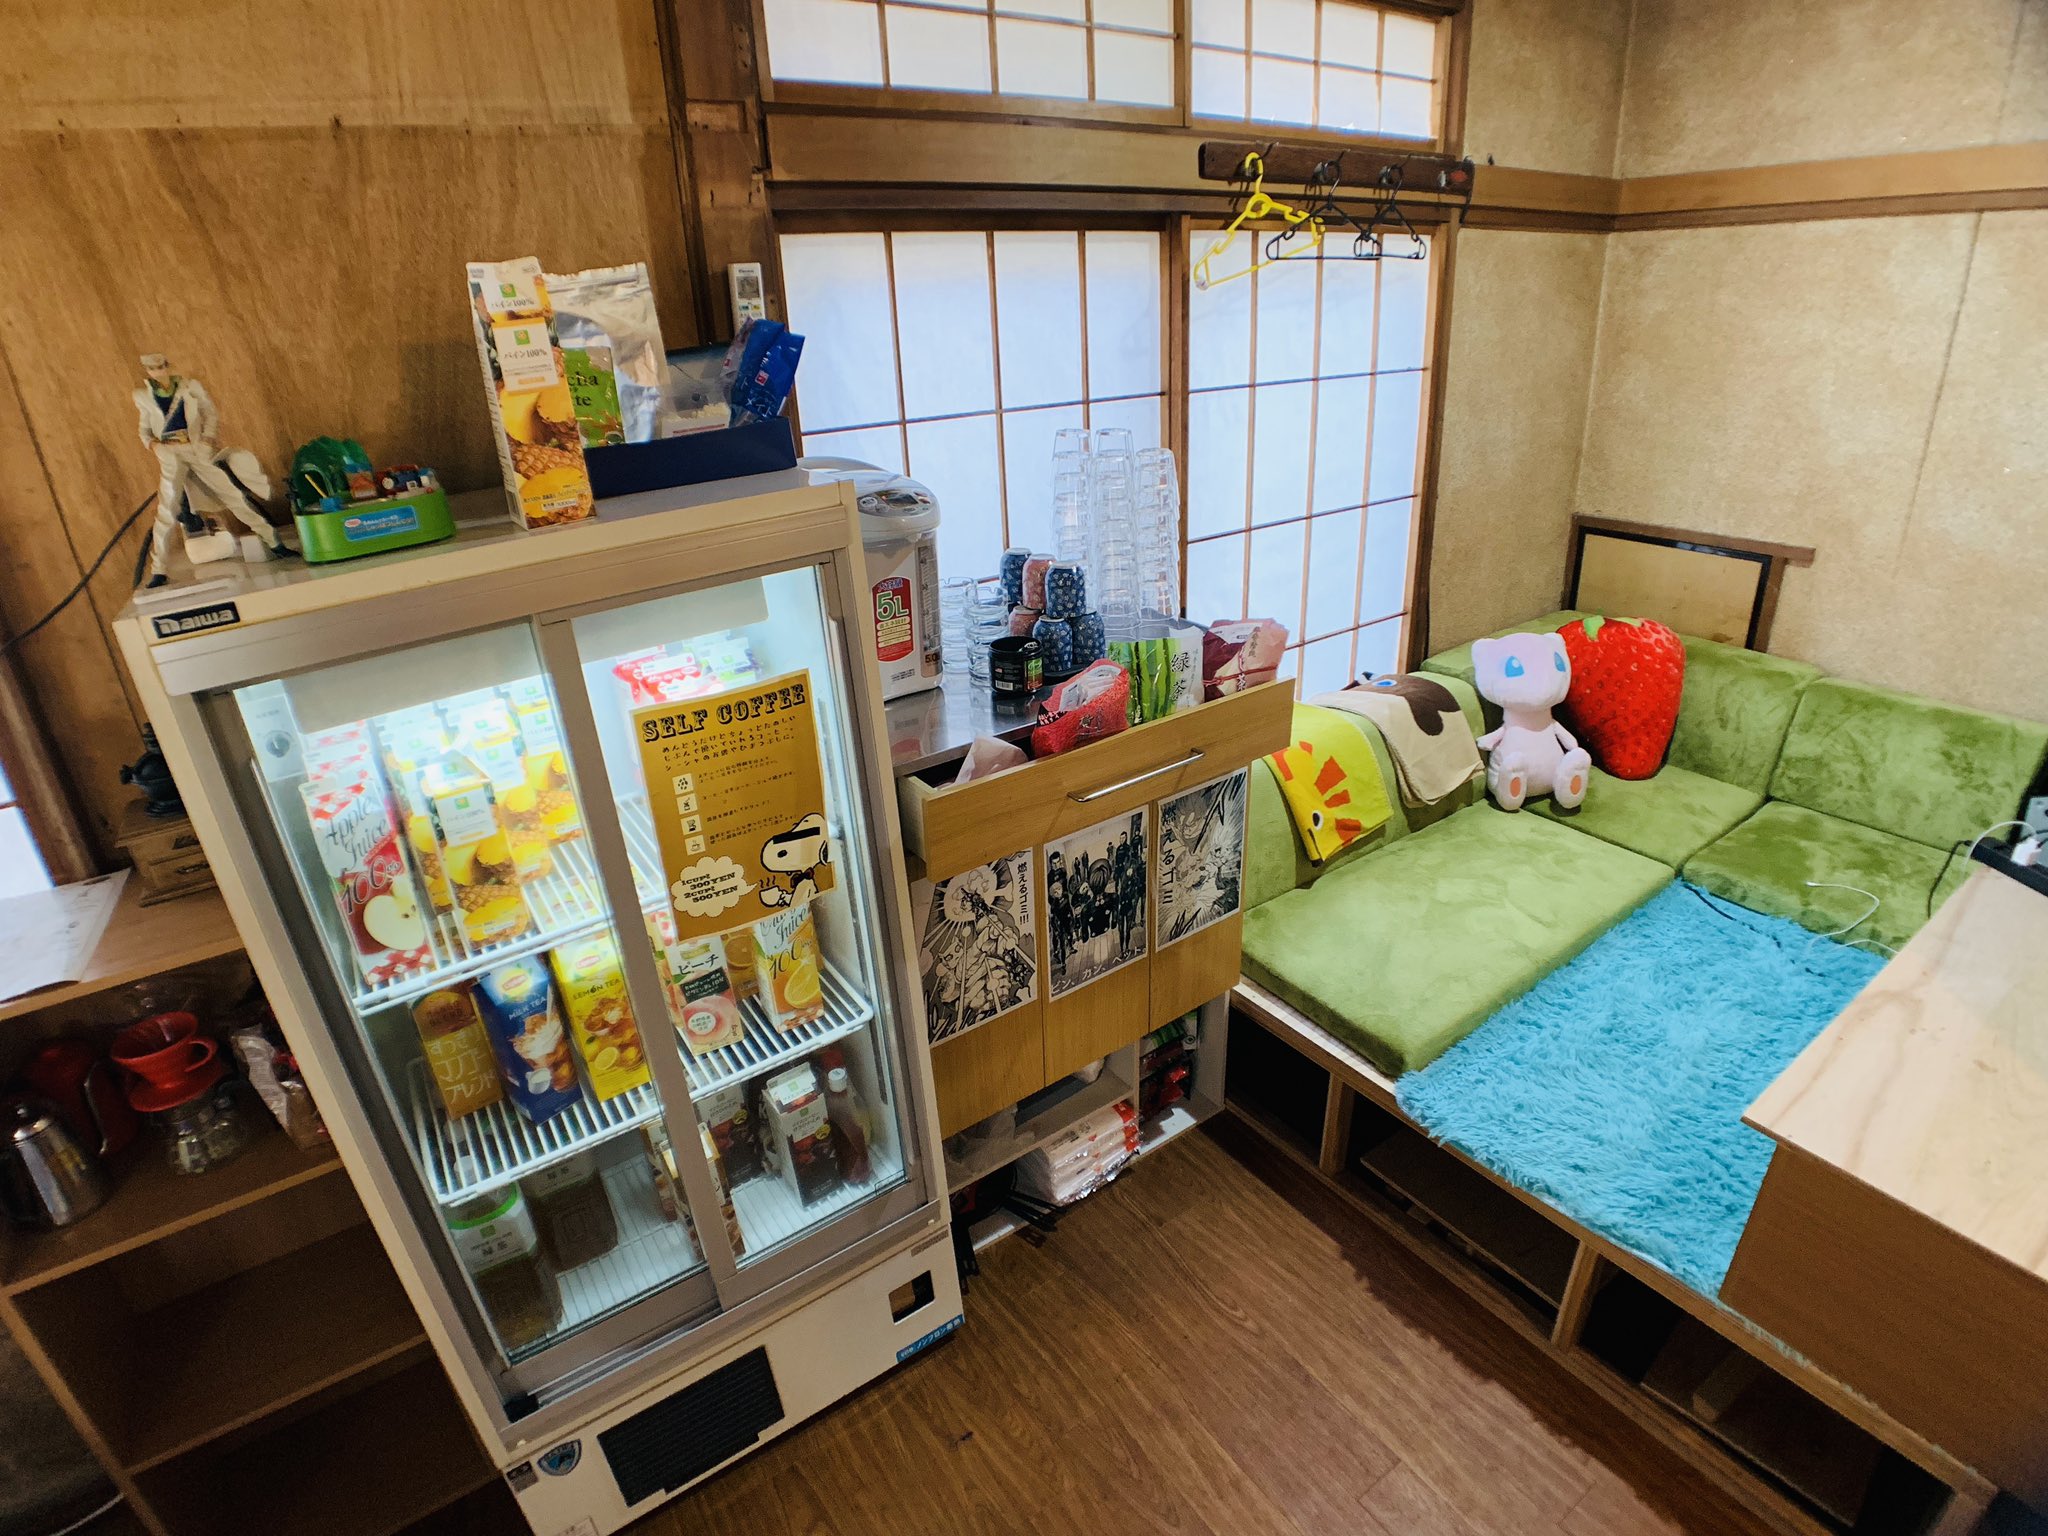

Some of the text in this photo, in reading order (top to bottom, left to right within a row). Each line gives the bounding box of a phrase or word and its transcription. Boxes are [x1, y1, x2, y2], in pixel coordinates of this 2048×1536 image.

[876, 591, 910, 621] 5L
[642, 683, 806, 743] SELF COFFEE
[529, 996, 547, 1008] TEA
